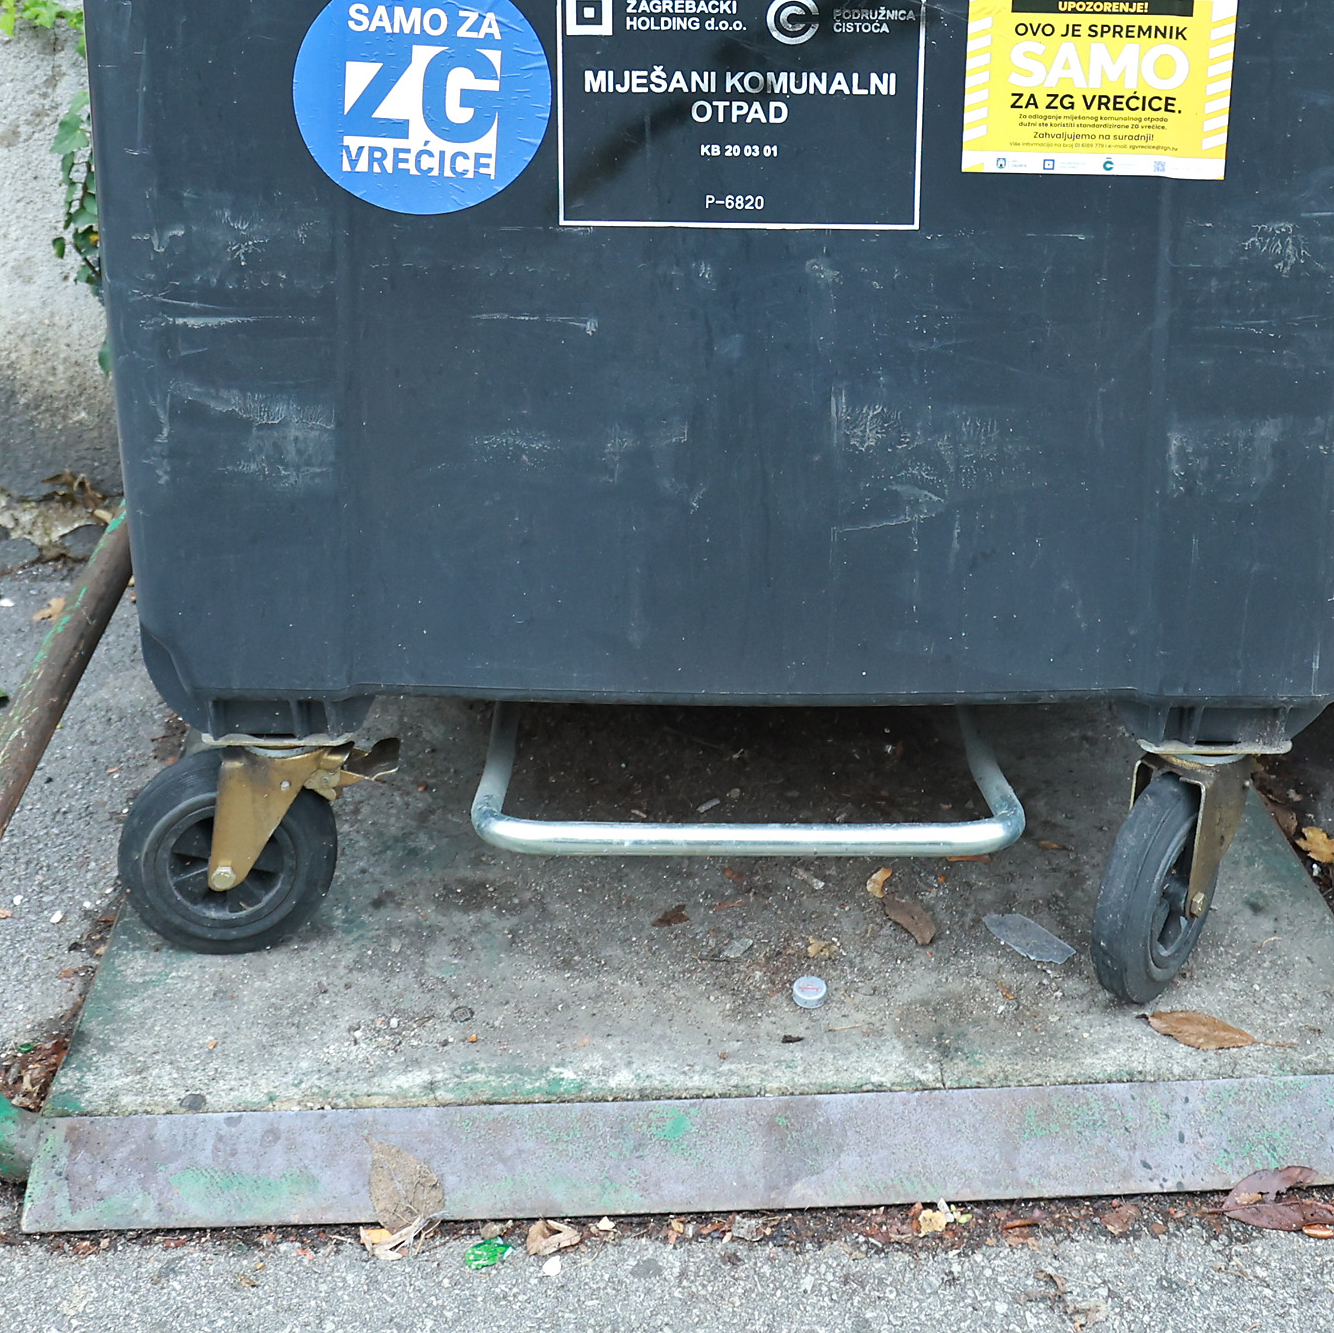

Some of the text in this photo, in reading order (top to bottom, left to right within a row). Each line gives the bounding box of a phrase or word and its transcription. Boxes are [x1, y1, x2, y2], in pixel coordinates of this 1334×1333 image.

[833, 5, 916, 22] PODRUŽNICA
[1058, 0, 1149, 13] UPOZORENJE!
[347, 3, 502, 40] SAMO ZA
[626, 16, 747, 32] HOLDING d.o.o.
[833, 20, 889, 34] ČISTOĆA
[1014, 23, 1188, 40] OVO JE SPREMNIK
[1008, 40, 1190, 91] SAMO
[584, 66, 896, 95] MIJEŠANI KOMUNALNI
[343, 46, 500, 144] ZG
[1010, 91, 1182, 114] ZA ZG VREĆICE.
[691, 100, 788, 123] OTPAD
[1028, 113, 1062, 121] odlaganje
[1063, 114, 1098, 122] miješanog
[1033, 131, 1096, 141] Zahvaljujemo
[1113, 134, 1154, 143] suradnji!
[344, 141, 494, 178] VREĆICE
[700, 145, 778, 157] KB 20 03 01
[705, 195, 764, 210] P-6820
